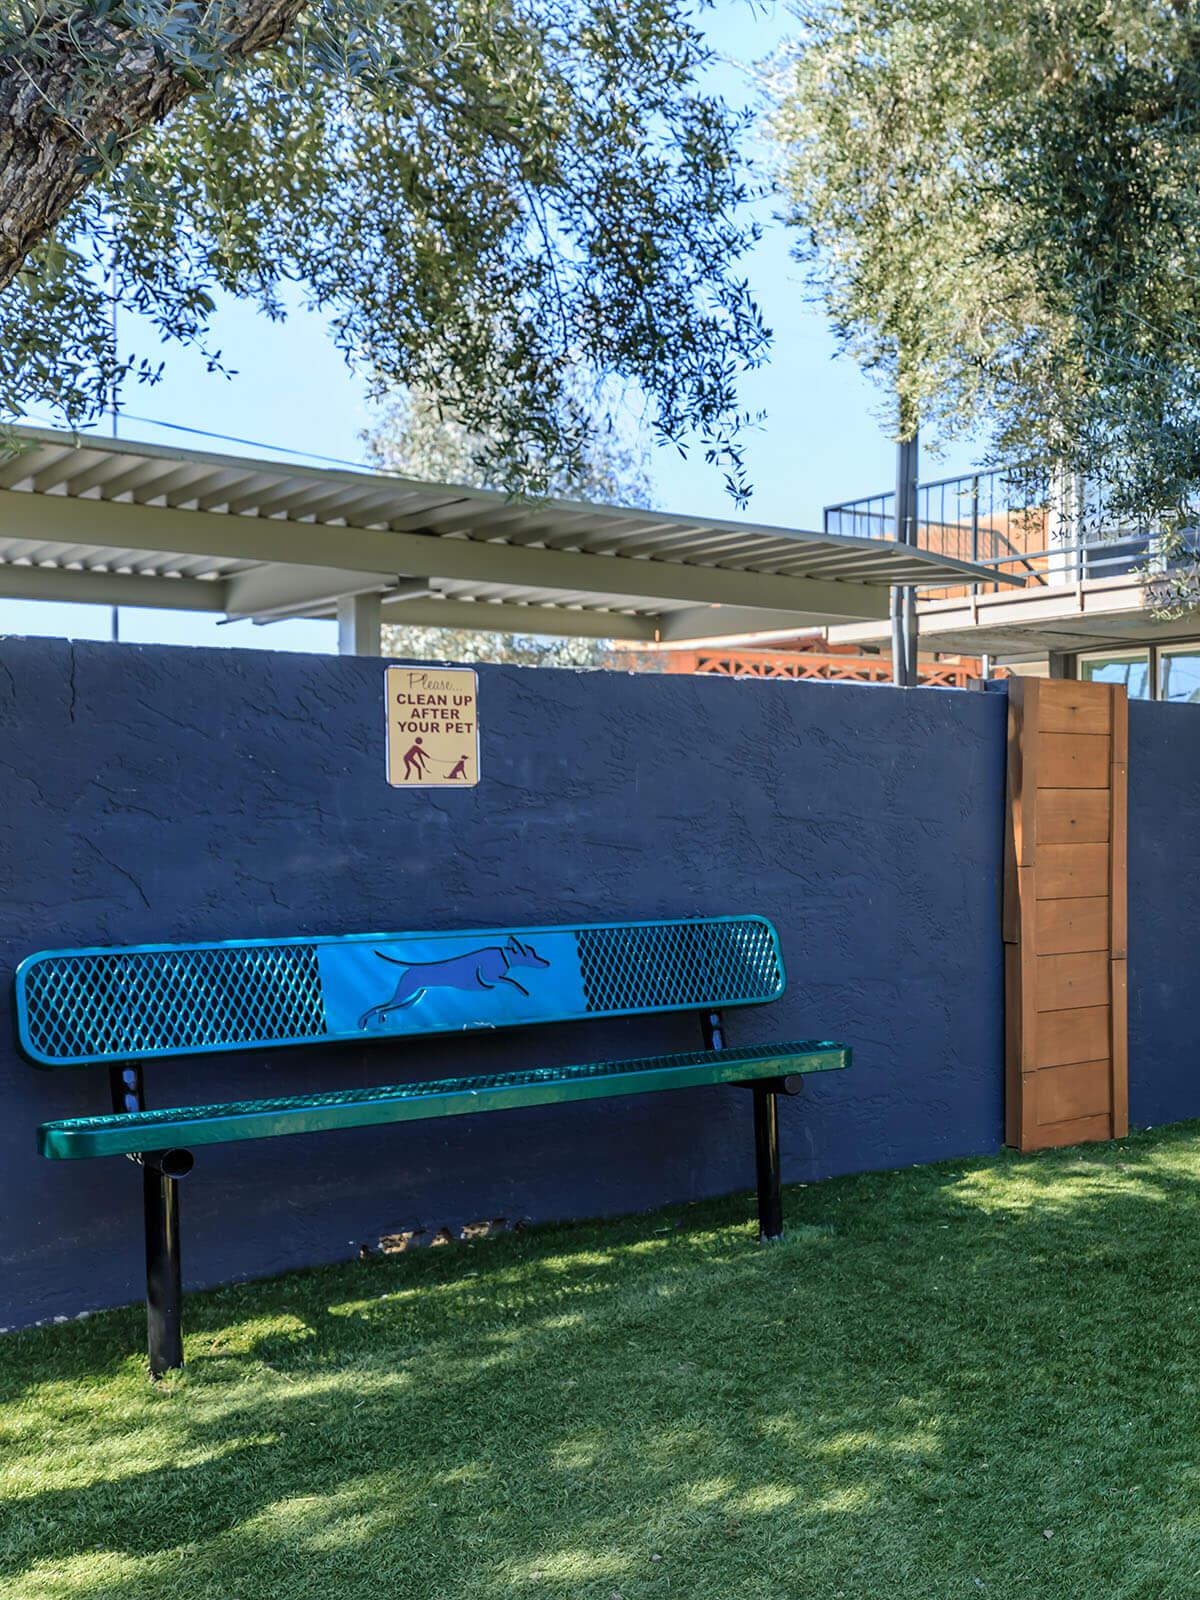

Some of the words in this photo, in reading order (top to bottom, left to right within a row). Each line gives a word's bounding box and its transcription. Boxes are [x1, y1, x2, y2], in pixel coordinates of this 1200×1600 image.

[396, 693, 447, 706] CLEAN
[453, 695, 472, 706] UP
[410, 708, 460, 719] AFTER
[398, 721, 440, 733] YOUR
[445, 722, 473, 733] PET
